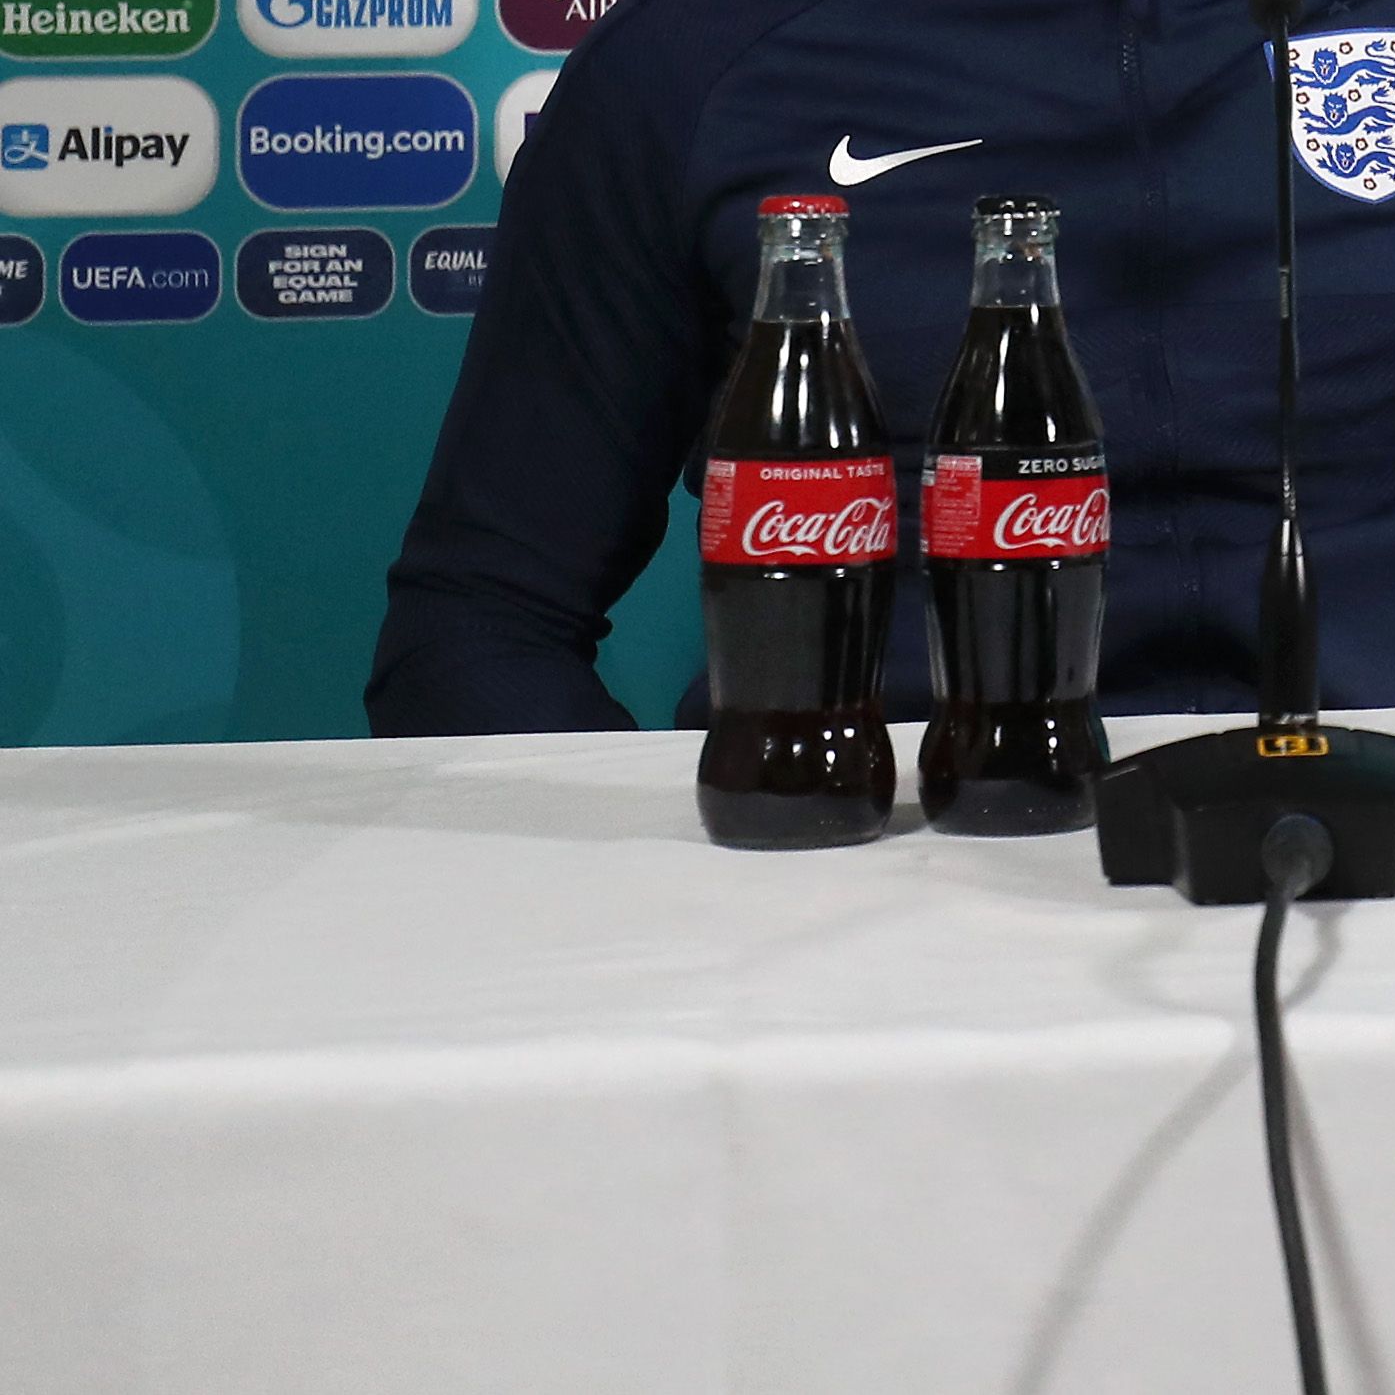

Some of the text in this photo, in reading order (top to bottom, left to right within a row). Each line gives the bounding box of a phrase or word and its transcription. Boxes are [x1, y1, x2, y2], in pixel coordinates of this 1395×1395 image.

[3, 2, 189, 34] Heineken
[58, 127, 189, 167] Alipay
[250, 124, 464, 159] Booking.com
[73, 266, 208, 289] UEFA.com
[269, 245, 362, 303] SIGN FOR AN EQUAL GAME
[760, 463, 885, 480] ORIGINAL TASTE
[1018, 459, 1068, 474] ZERO
[742, 498, 893, 556] Coca-Cola
